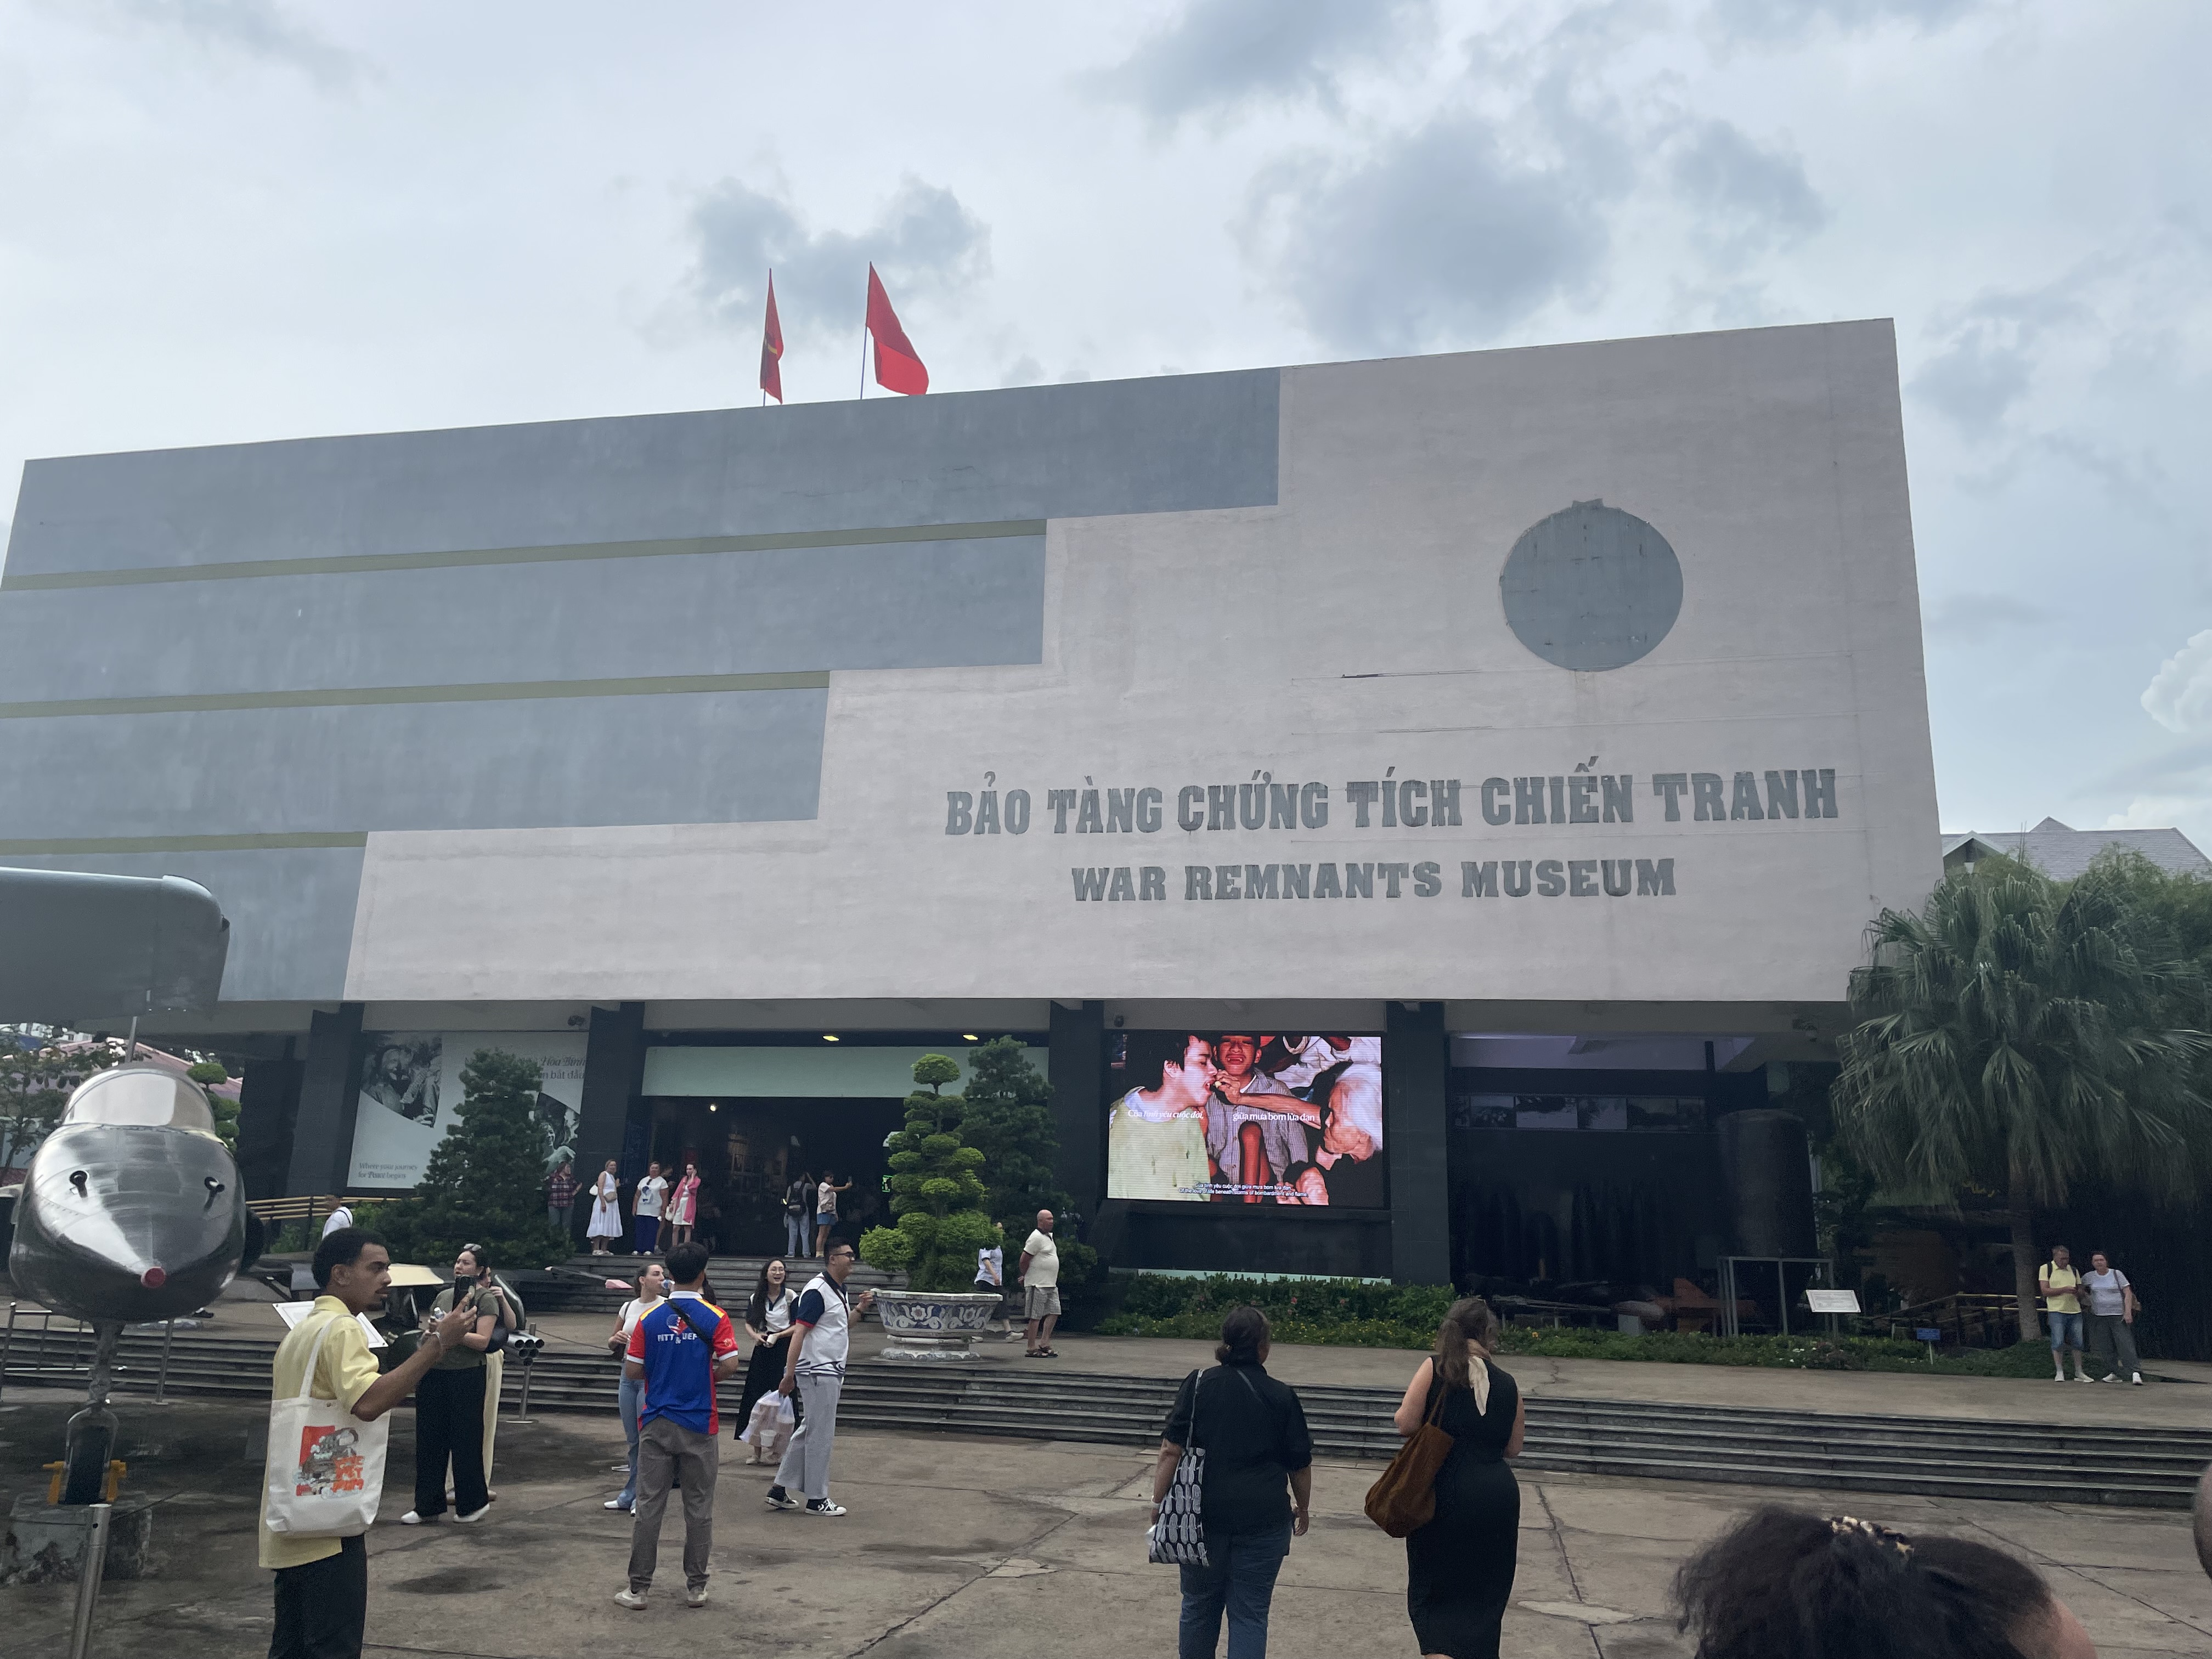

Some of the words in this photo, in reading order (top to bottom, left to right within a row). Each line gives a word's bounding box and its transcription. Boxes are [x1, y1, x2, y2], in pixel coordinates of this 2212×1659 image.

[945, 771, 1031, 835] BẢO
[1047, 775, 1163, 833] TÀNG
[1177, 770, 1329, 831] CHỨNG
[1346, 766, 1463, 827] TÍCH
[1481, 755, 1633, 827] CHIẾN
[1652, 769, 1839, 822] TRANH
[1071, 866, 1167, 901] WAR
[1184, 861, 1442, 900] REMNANTS
[1462, 858, 1677, 898] MUSEUM
[1268, 1113, 1286, 1121] bom
